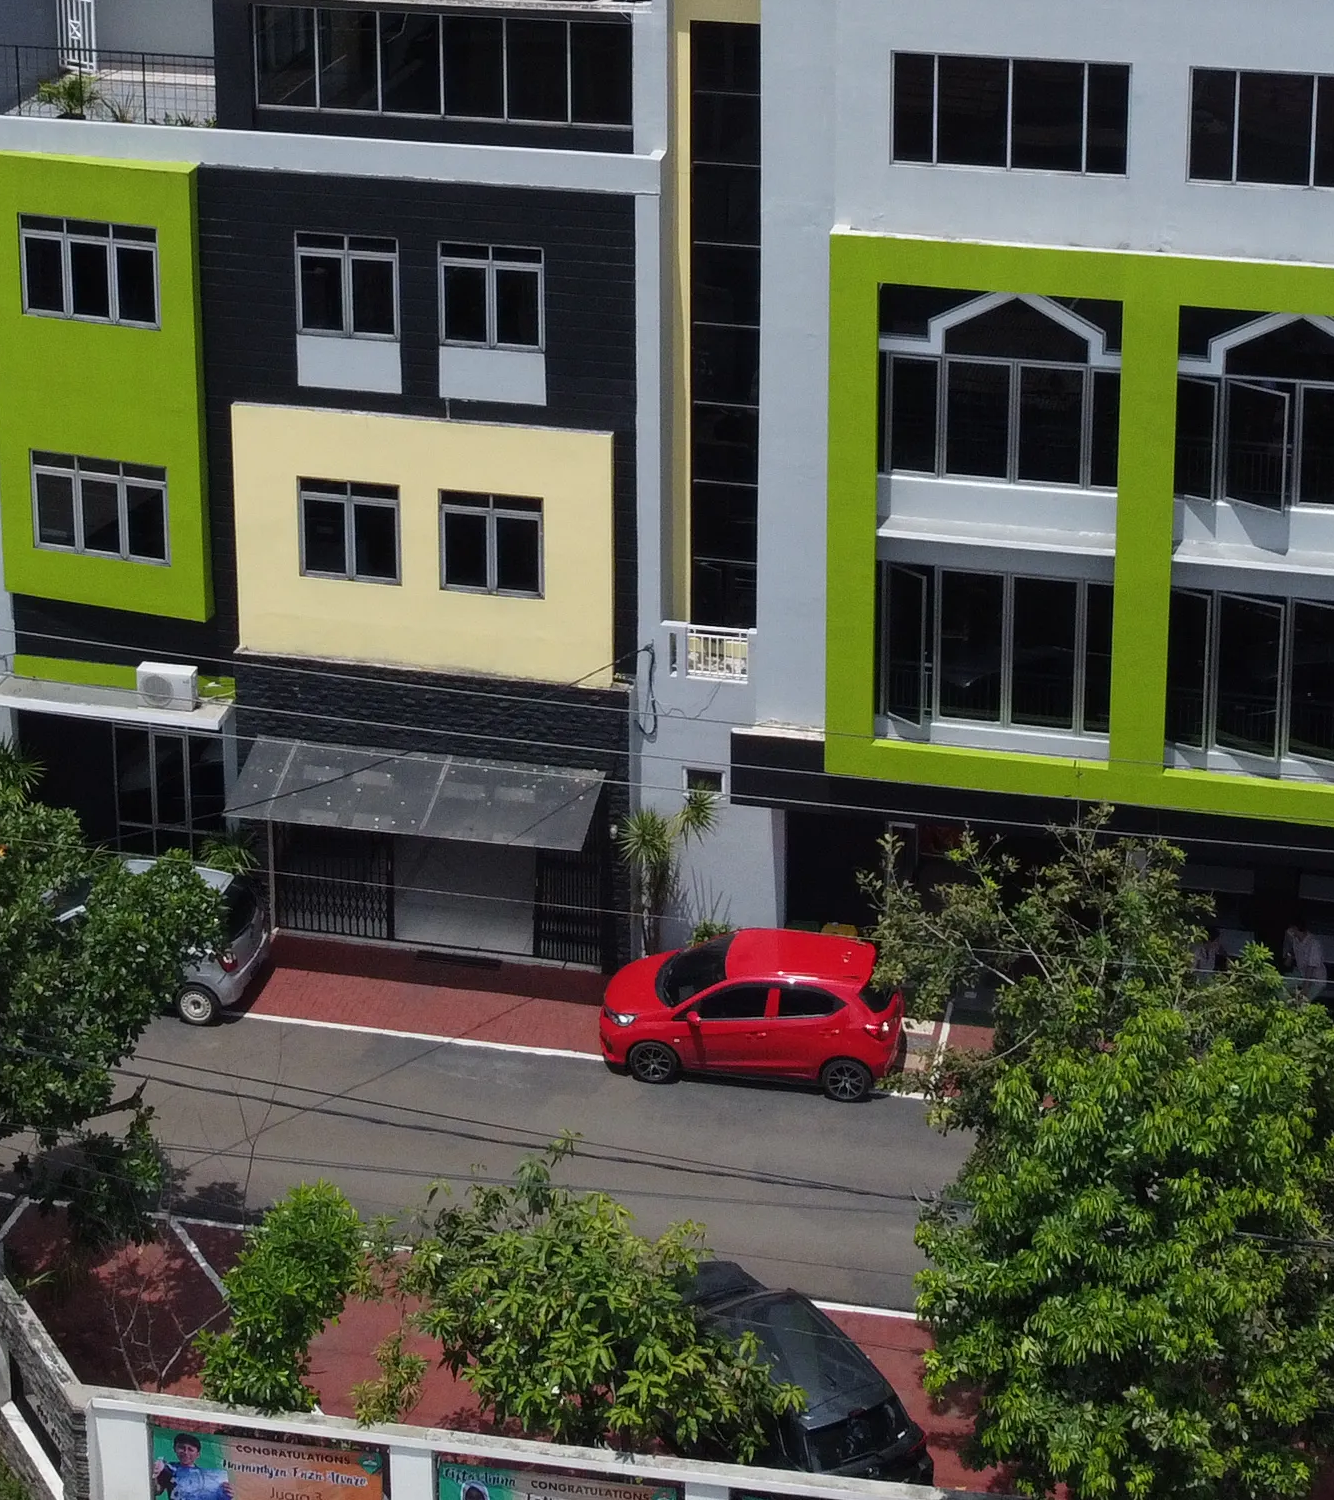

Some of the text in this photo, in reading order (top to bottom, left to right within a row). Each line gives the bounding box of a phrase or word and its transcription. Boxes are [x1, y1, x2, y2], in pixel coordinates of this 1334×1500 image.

[236, 1445, 351, 1465] CONGRATULATIONS
[270, 1487, 310, 1500] Juara
[530, 1479, 650, 1500] CONGRATULATIONS
